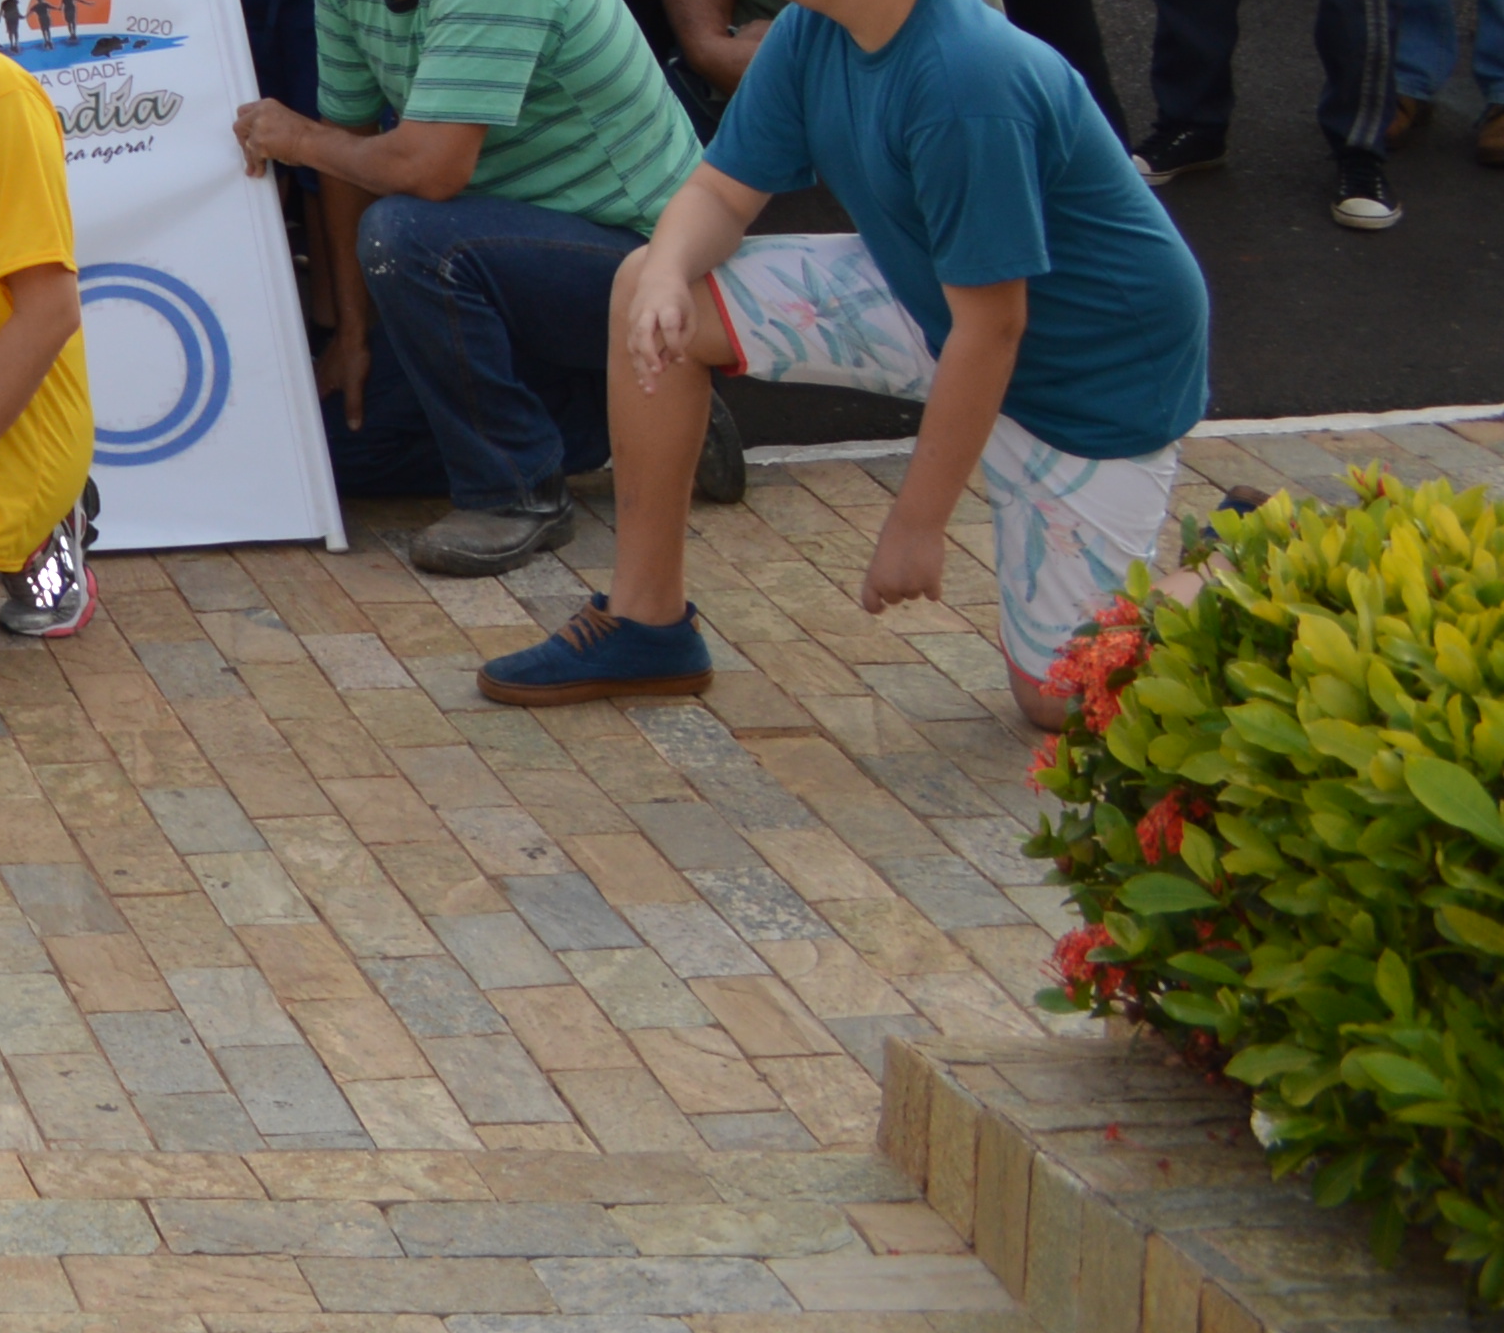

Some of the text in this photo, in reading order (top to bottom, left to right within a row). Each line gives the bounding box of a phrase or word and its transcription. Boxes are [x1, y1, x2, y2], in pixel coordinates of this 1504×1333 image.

[126, 16, 173, 36] 2020
[57, 62, 126, 86] CIDADE
[91, 136, 154, 164] agora!
